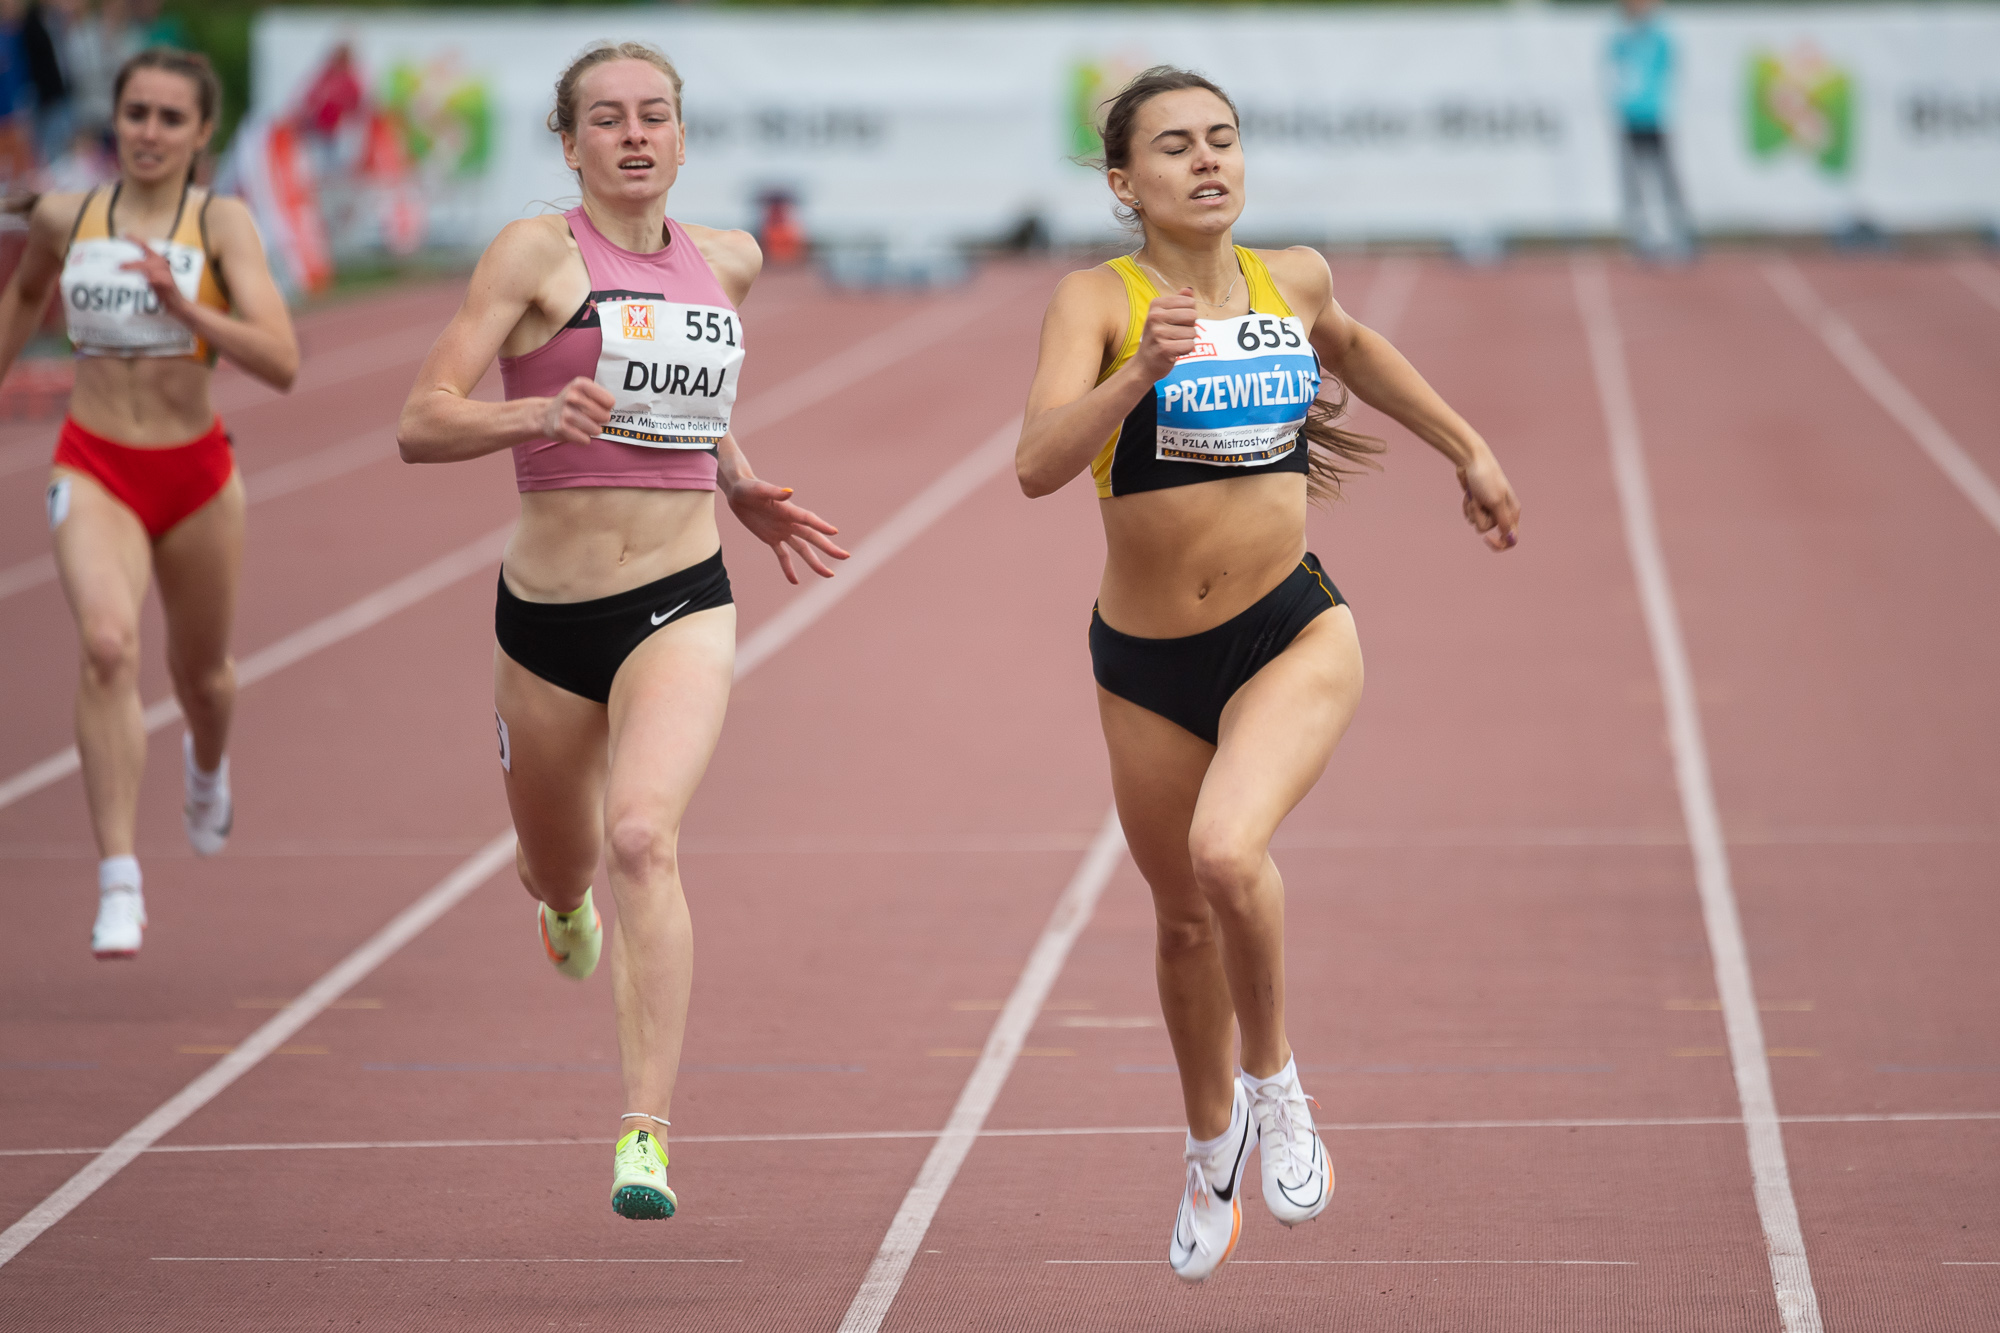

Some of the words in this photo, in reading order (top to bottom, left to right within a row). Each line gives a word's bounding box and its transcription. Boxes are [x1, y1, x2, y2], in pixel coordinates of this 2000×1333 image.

[624, 327, 653, 339] PZLA
[686, 310, 736, 347] 551
[1237, 319, 1301, 352] 655
[622, 360, 726, 398] DURAJ
[1164, 363, 1316, 413] PRZEWIEŹLIK
[637, 417, 686, 431] Mistrzostwa
[688, 421, 710, 431] Polski
[1161, 436, 1178, 446] 54.
[1182, 439, 1210, 449] PZLA
